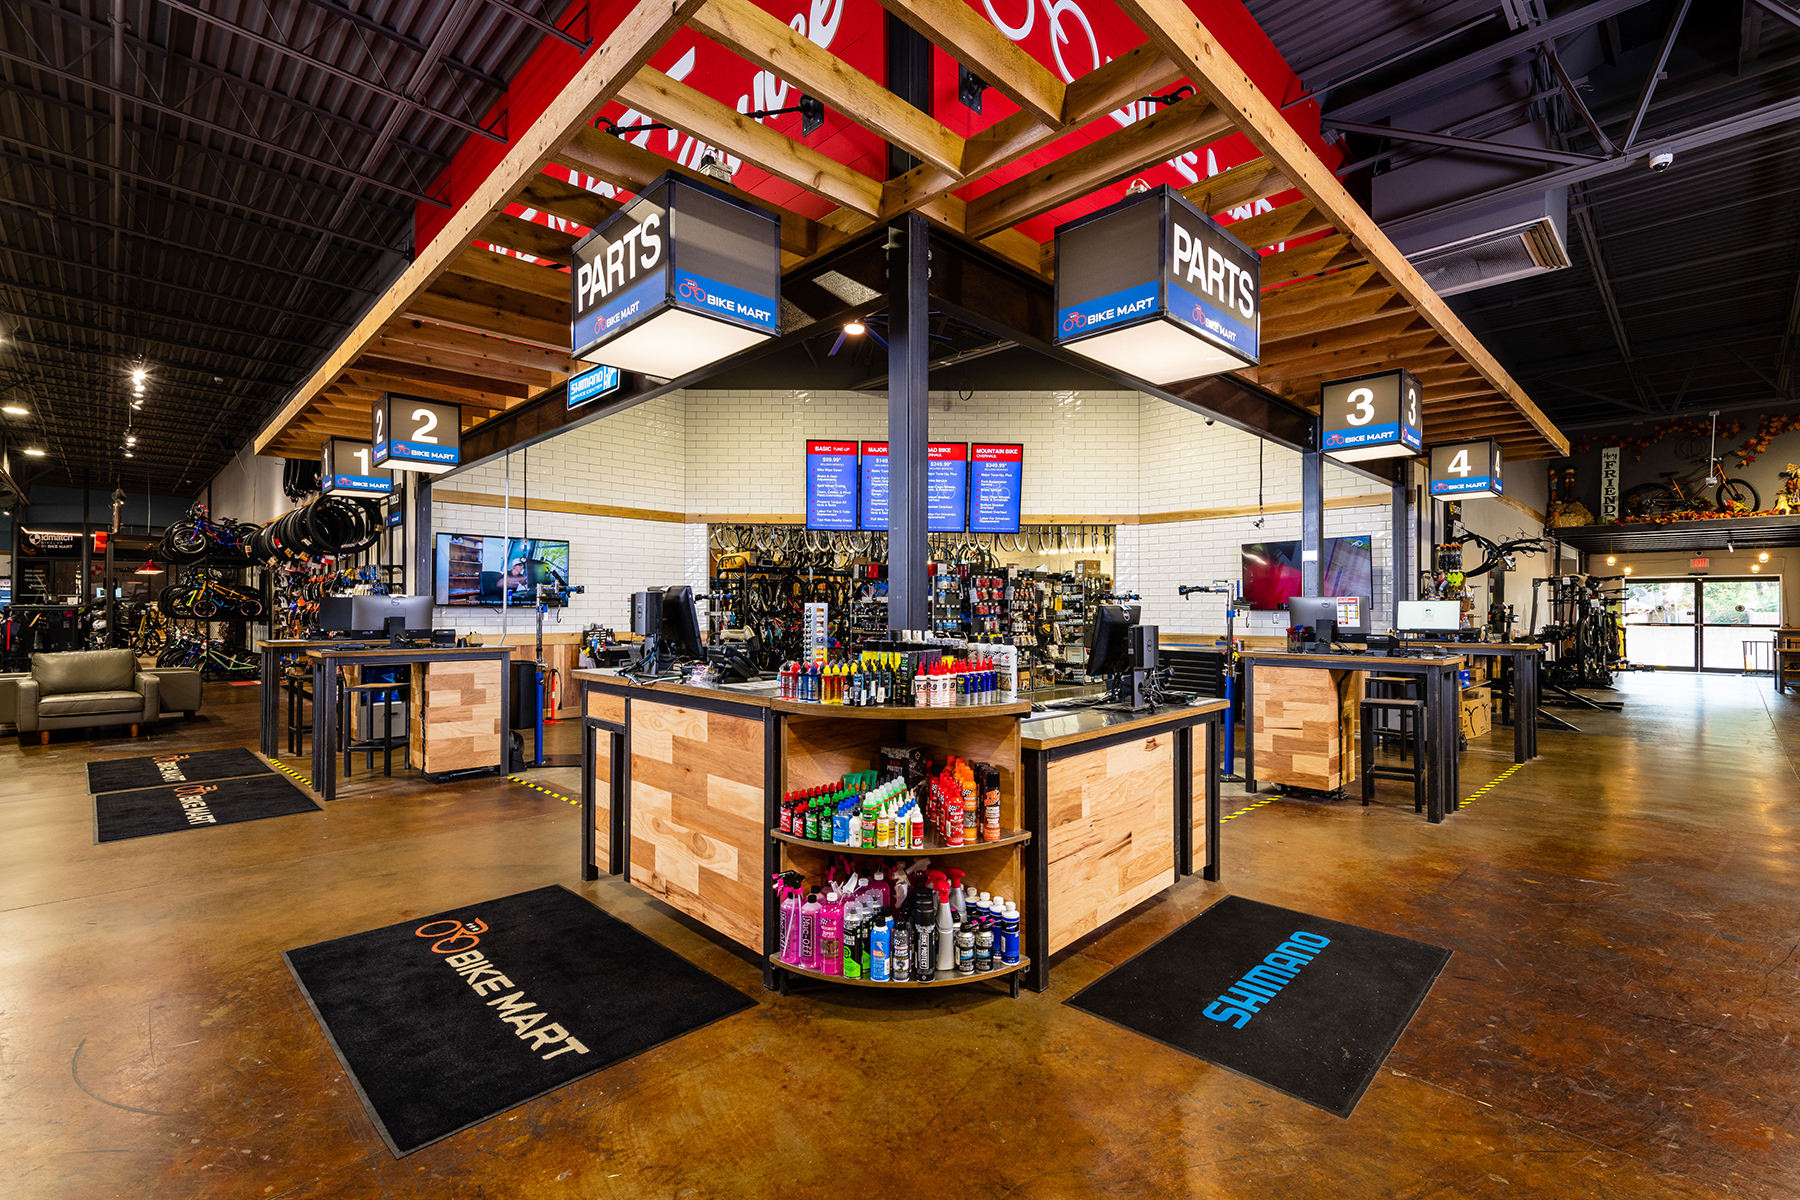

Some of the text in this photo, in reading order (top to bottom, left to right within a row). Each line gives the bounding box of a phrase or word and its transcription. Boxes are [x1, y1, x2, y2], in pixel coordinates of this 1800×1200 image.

[577, 213, 662, 314] PARTS
[1173, 222, 1254, 319] PARTS
[606, 300, 640, 327] BIKE MART
[707, 294, 771, 322] BIKE MART
[1087, 297, 1155, 325] BIKE MART
[1204, 317, 1237, 342] BIKE MART
[570, 370, 603, 395] SHIMANO
[571, 383, 603, 401] SERVICE CENTER
[1345, 387, 1375, 426] 3
[1408, 388, 1416, 426] 3
[376, 409, 383, 444] 2
[411, 408, 438, 444] 2
[1345, 431, 1394, 444] BIKE MART
[324, 448, 329, 476] 1
[353, 448, 369, 476] 1
[410, 449, 455, 461] BIKE MART
[1447, 449, 1471, 478] 4
[1494, 450, 1500, 478] 4
[1603, 452, 1617, 460] Hey
[369, 482, 389, 490] MART
[1448, 482, 1464, 490] BIKE
[1466, 481, 1487, 489] MART
[179, 795, 217, 825] BIKE MART
[803, 917, 812, 957] Muc-Off
[1202, 931, 1331, 1030] SHIMANO
[445, 949, 590, 1061] BIKE MART
